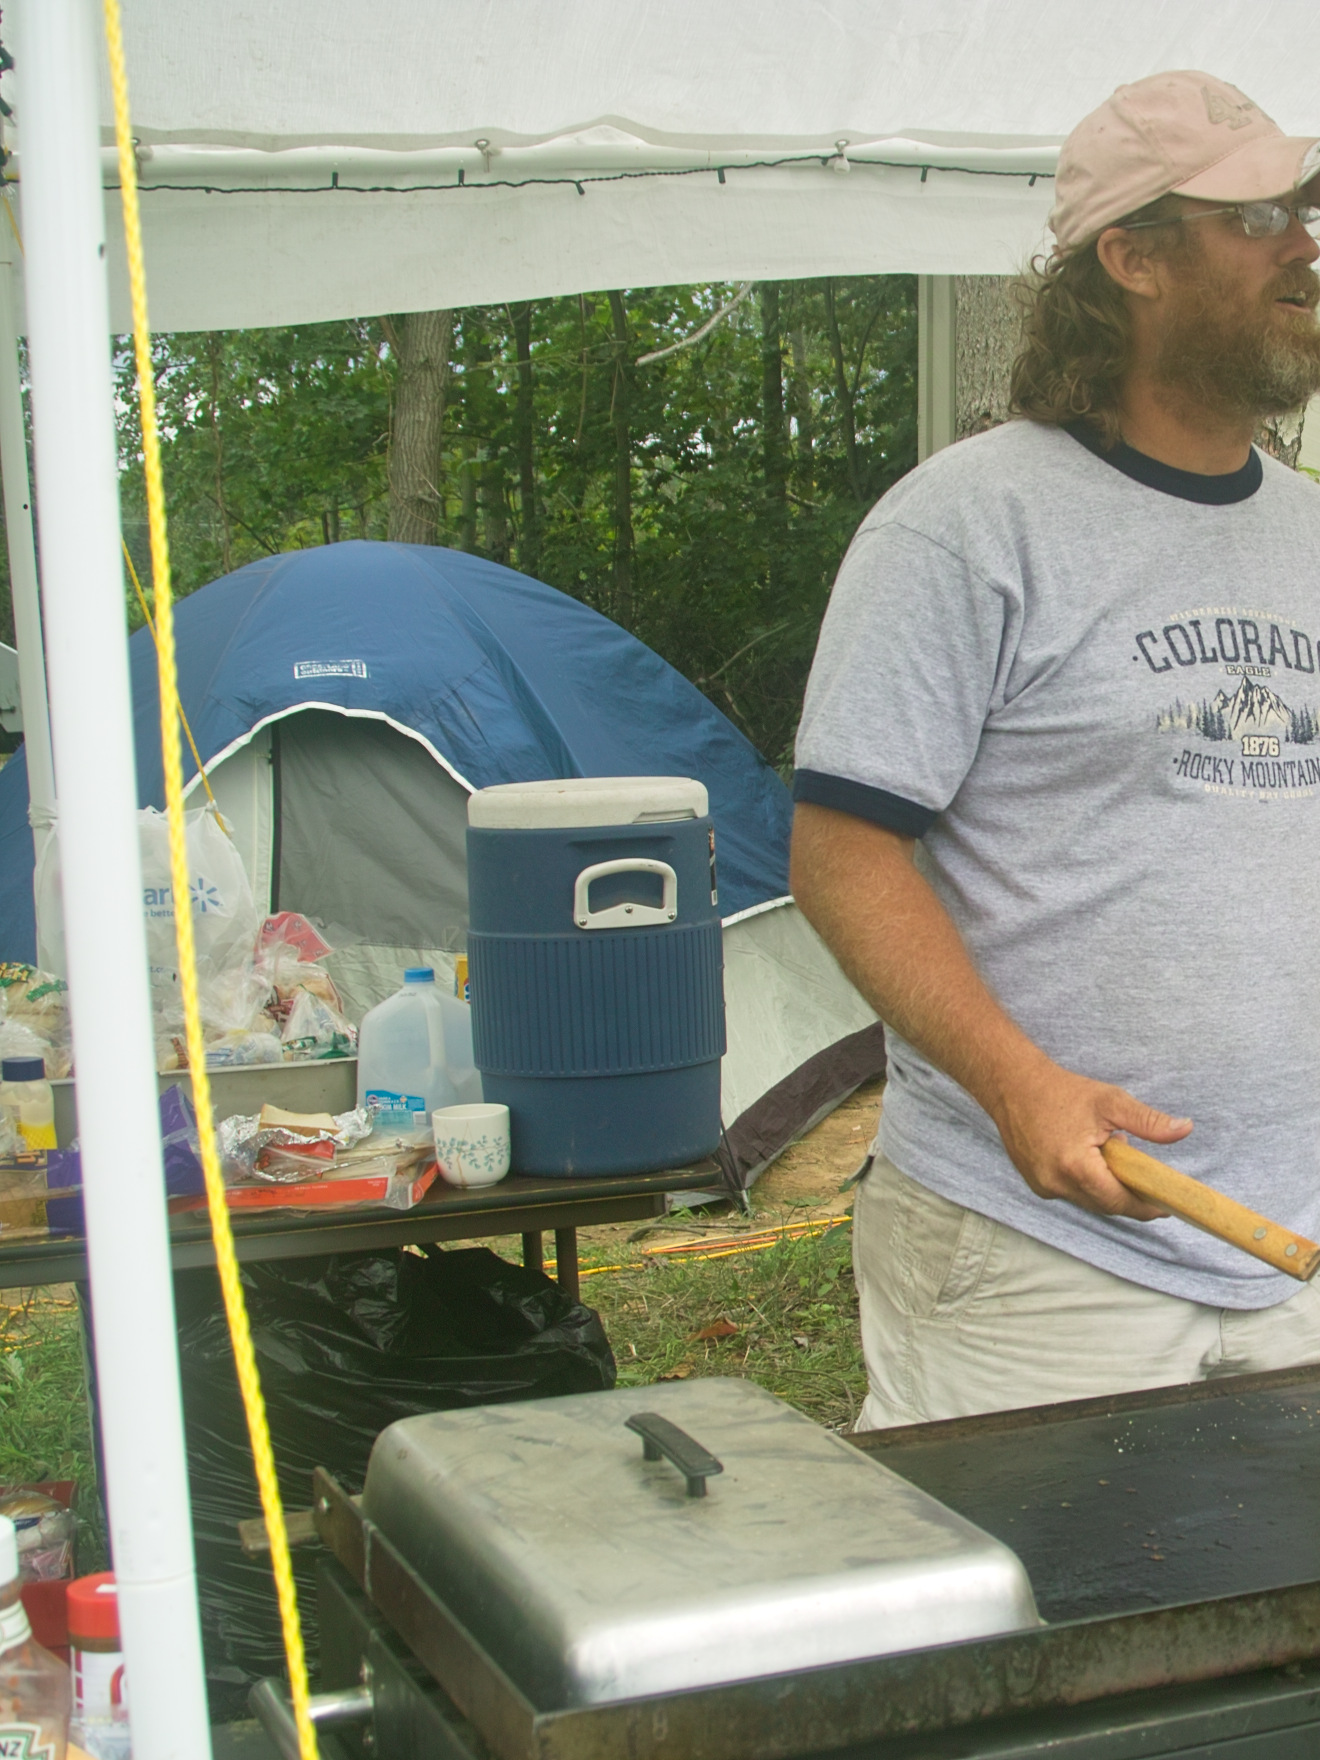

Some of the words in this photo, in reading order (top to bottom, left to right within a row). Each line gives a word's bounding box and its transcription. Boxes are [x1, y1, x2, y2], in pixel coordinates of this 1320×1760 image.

[1226, 665, 1272, 678] EAGLE
[1241, 735, 1280, 757] 1876
[1176, 749, 1235, 785] ROCKY
[1203, 783, 1255, 799] QUALITY
[1259, 787, 1279, 799] DRY
